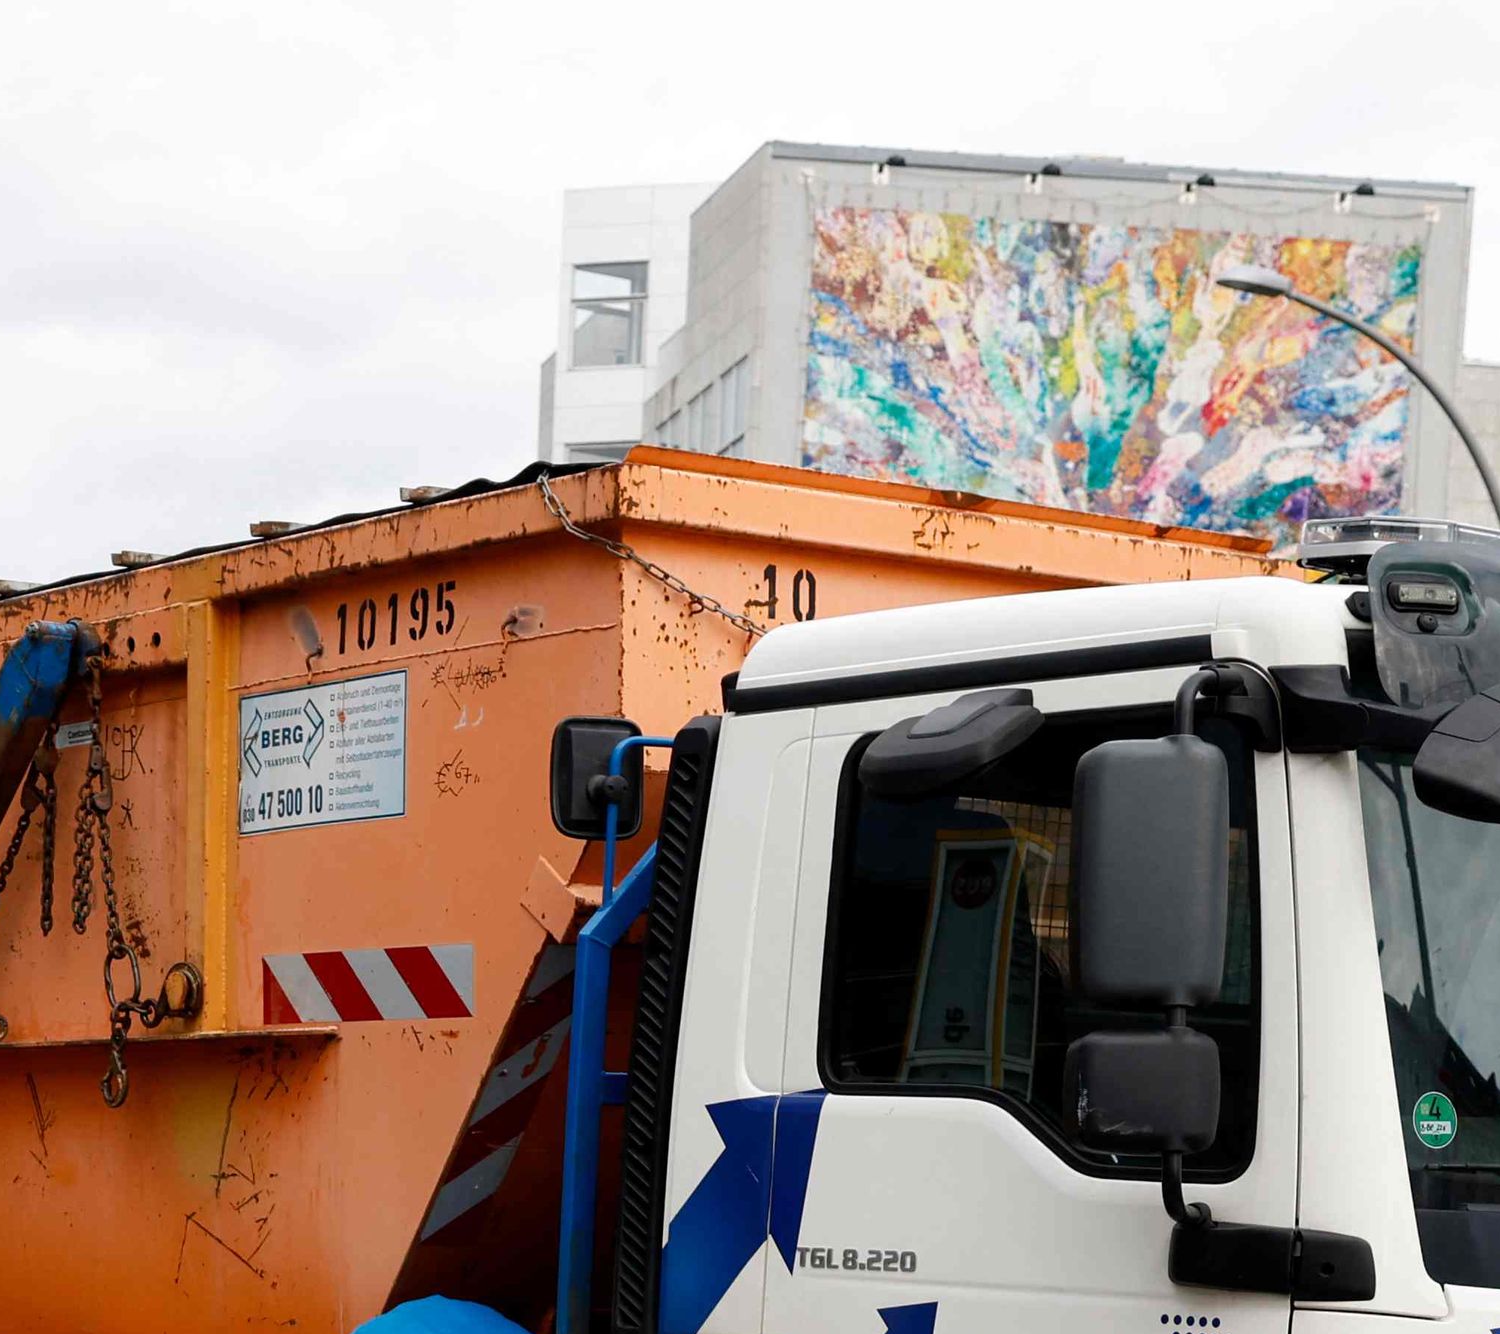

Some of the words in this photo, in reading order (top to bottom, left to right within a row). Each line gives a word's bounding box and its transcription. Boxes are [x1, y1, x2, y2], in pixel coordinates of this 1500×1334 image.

[763, 563, 816, 622] 10
[336, 580, 456, 655] 10195
[263, 706, 303, 721] ENTSORGUNG
[261, 724, 304, 749] BERG
[263, 754, 302, 769] TRANSPORTE
[258, 791, 274, 821] 47
[277, 787, 303, 818] 500
[307, 784, 323, 814] 10
[1428, 1096, 1442, 1120] 4
[797, 1247, 840, 1271] TGL
[841, 1248, 917, 1273] 8.220
